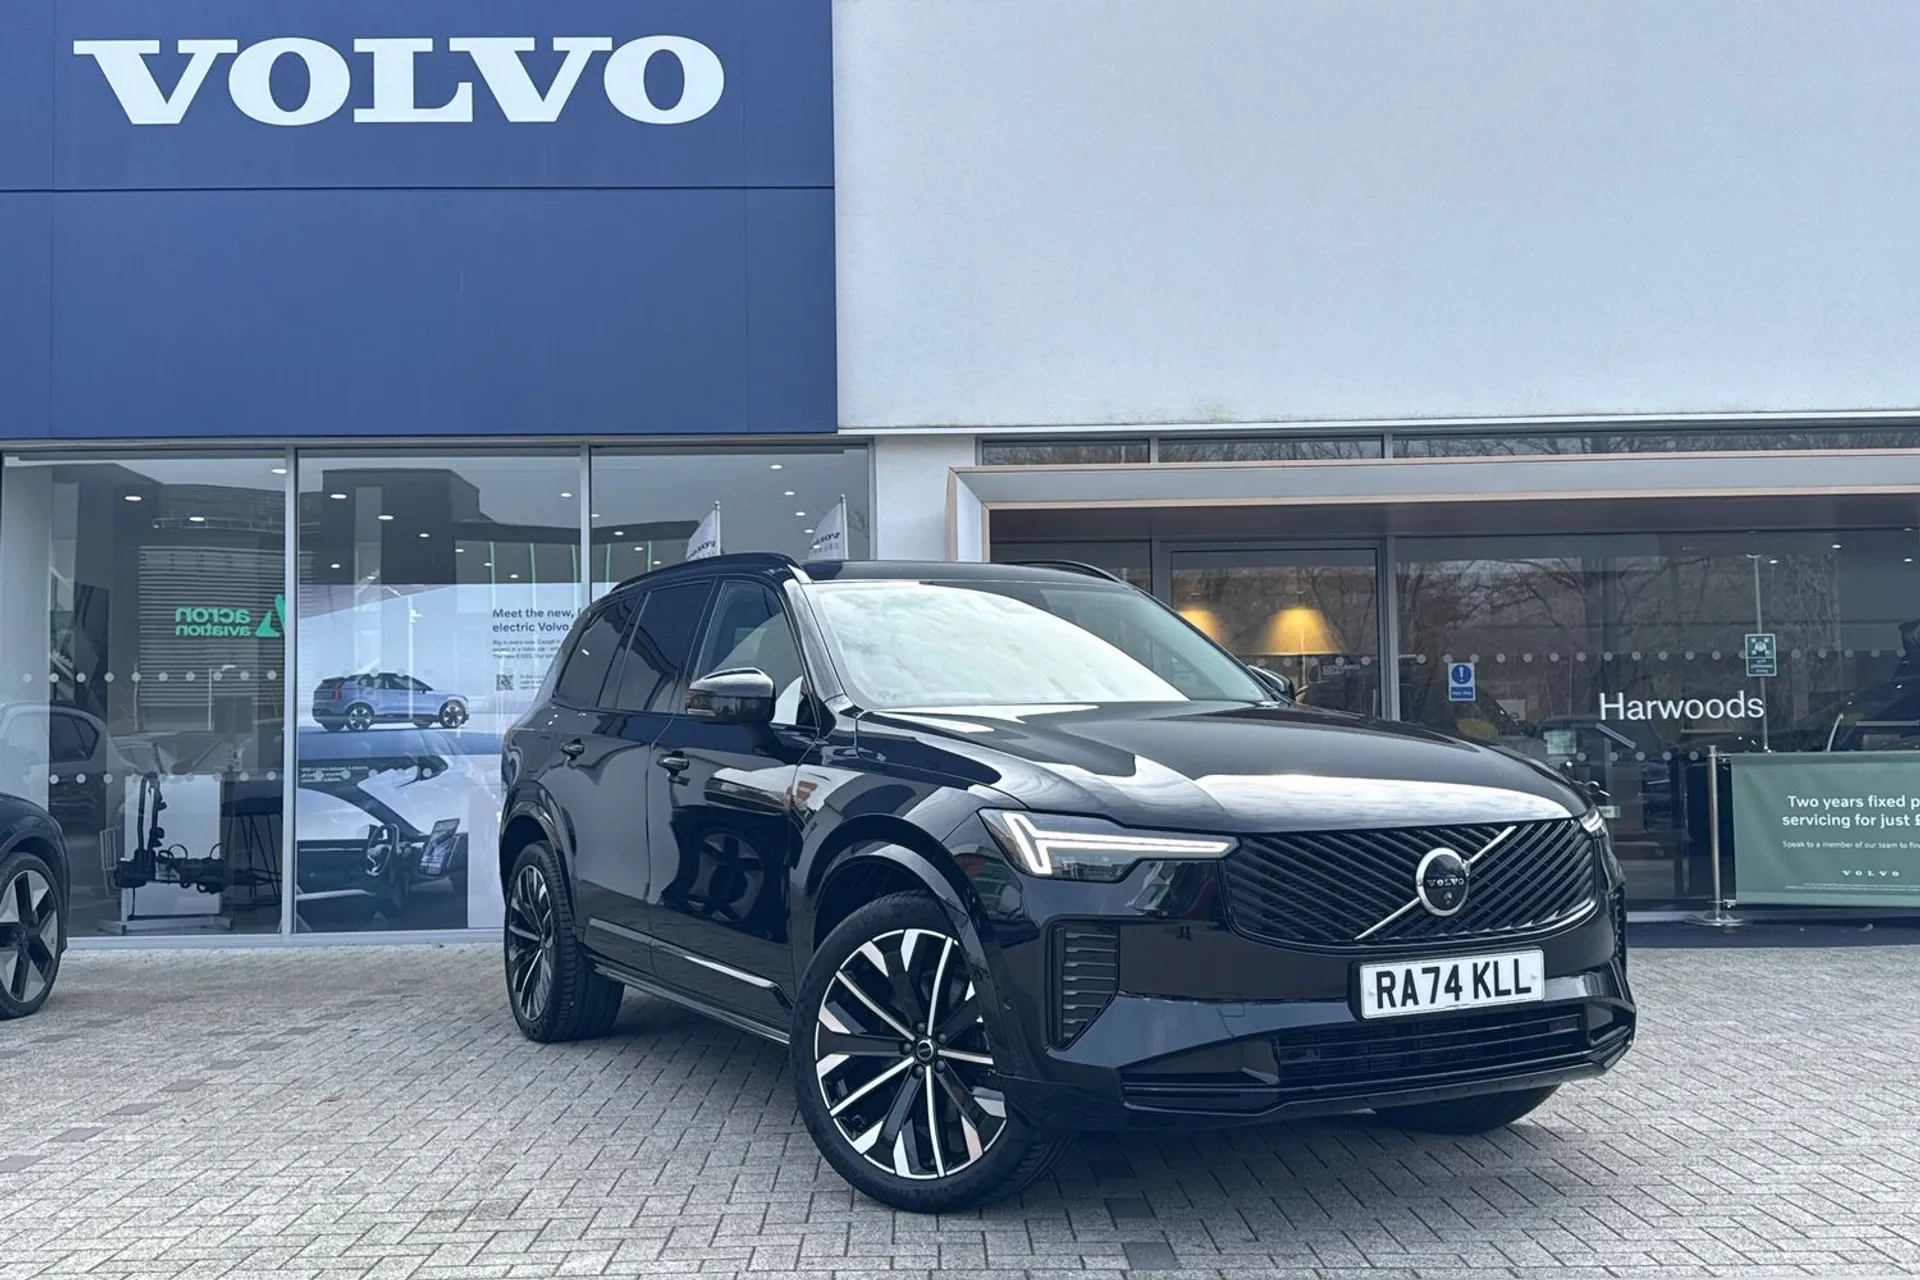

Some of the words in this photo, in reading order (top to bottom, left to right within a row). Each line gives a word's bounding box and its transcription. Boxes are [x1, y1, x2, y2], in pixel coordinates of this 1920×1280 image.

[74, 36, 724, 125] VOLVO
[492, 608, 523, 618] Meet
[526, 608, 544, 618] the
[547, 610, 574, 619] new,
[493, 622, 535, 632] electric
[538, 622, 569, 632] Volvo
[1599, 690, 1765, 721] Harwoods
[1787, 795, 1819, 808] Two
[1823, 798, 1864, 811] years
[1868, 795, 1906, 808] fixed
[1782, 813, 1851, 829] servicing
[1854, 813, 1877, 826] for
[1880, 814, 1911, 829] just
[1782, 840, 1805, 849] Speak
[1822, 840, 1853, 849] member
[1854, 841, 1863, 849] of
[1878, 841, 1898, 849] team
[1900, 841, 1908, 849] to
[1427, 878, 1465, 887] VOLVO
[1376, 965, 1463, 1009] RA74
[1473, 958, 1531, 999] KLL
